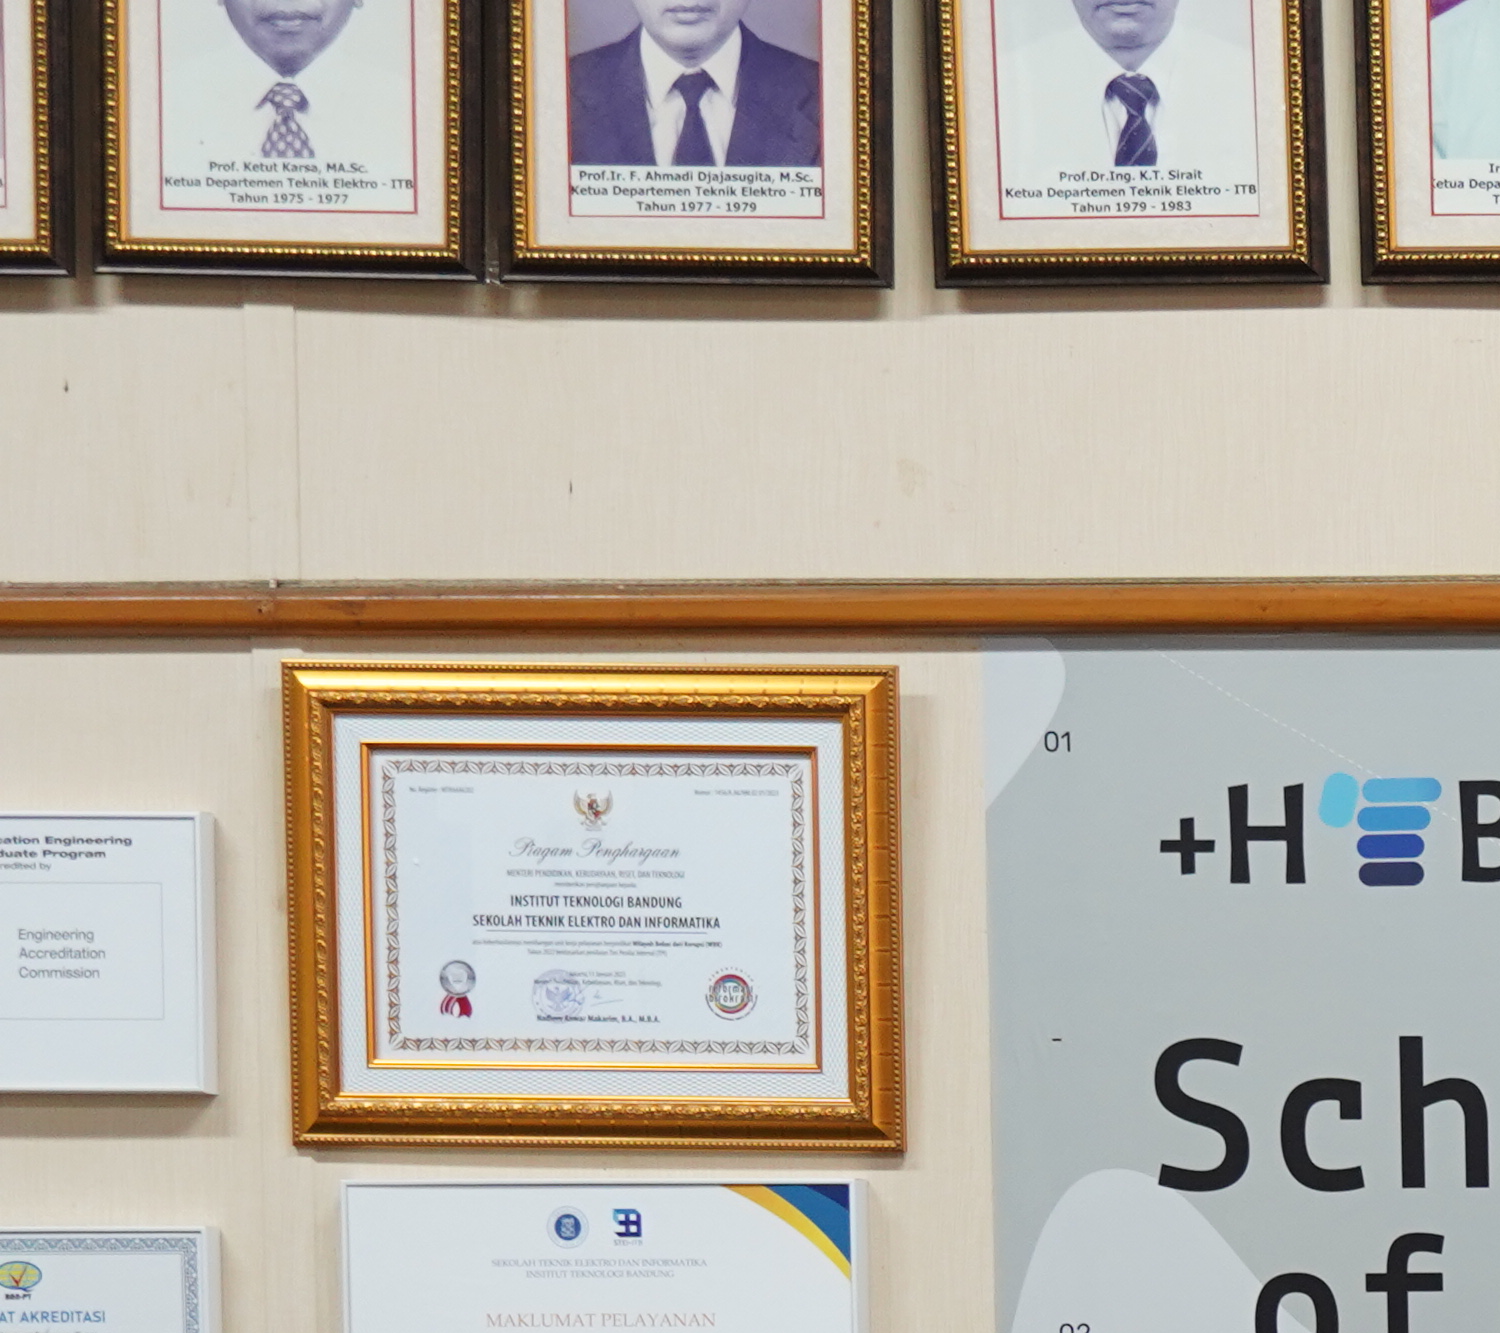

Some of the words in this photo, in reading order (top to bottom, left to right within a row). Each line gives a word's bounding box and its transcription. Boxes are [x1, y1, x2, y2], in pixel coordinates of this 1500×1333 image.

[209, 161, 239, 173] Prof.
[244, 161, 278, 173] Ketut
[283, 161, 322, 176] Karsa,
[579, 169, 626, 182] Prof.Ir.
[629, 170, 641, 182] F.
[644, 170, 694, 182] Ahmadi
[697, 170, 775, 185] Djajasugita,
[779, 171, 814, 183] M.Sc.
[1059, 170, 1136, 184] Prof.Dr.Ing.
[1139, 169, 1164, 181] K.T.
[1168, 169, 1203, 181] Sirait
[1042, 729, 1072, 754] 01
[510, 894, 560, 908] INSTITUT
[562, 895, 624, 908] TEKNOLOGI
[626, 895, 682, 909] BANDUNG
[472, 914, 523, 927] SEKOLAH
[524, 914, 565, 928] TEKNIK
[567, 915, 616, 928] ELEKTRO
[618, 915, 642, 929] DAN
[644, 916, 721, 929] INFORMATIKA
[17, 928, 95, 944] Engineering
[18, 946, 106, 960] Accreditation
[17, 965, 101, 980] Commission
[19, 1310, 106, 1324] AKREDITASI
[486, 1312, 597, 1328] MAKLUMAT
[601, 1312, 716, 1328] PELAYANAN
